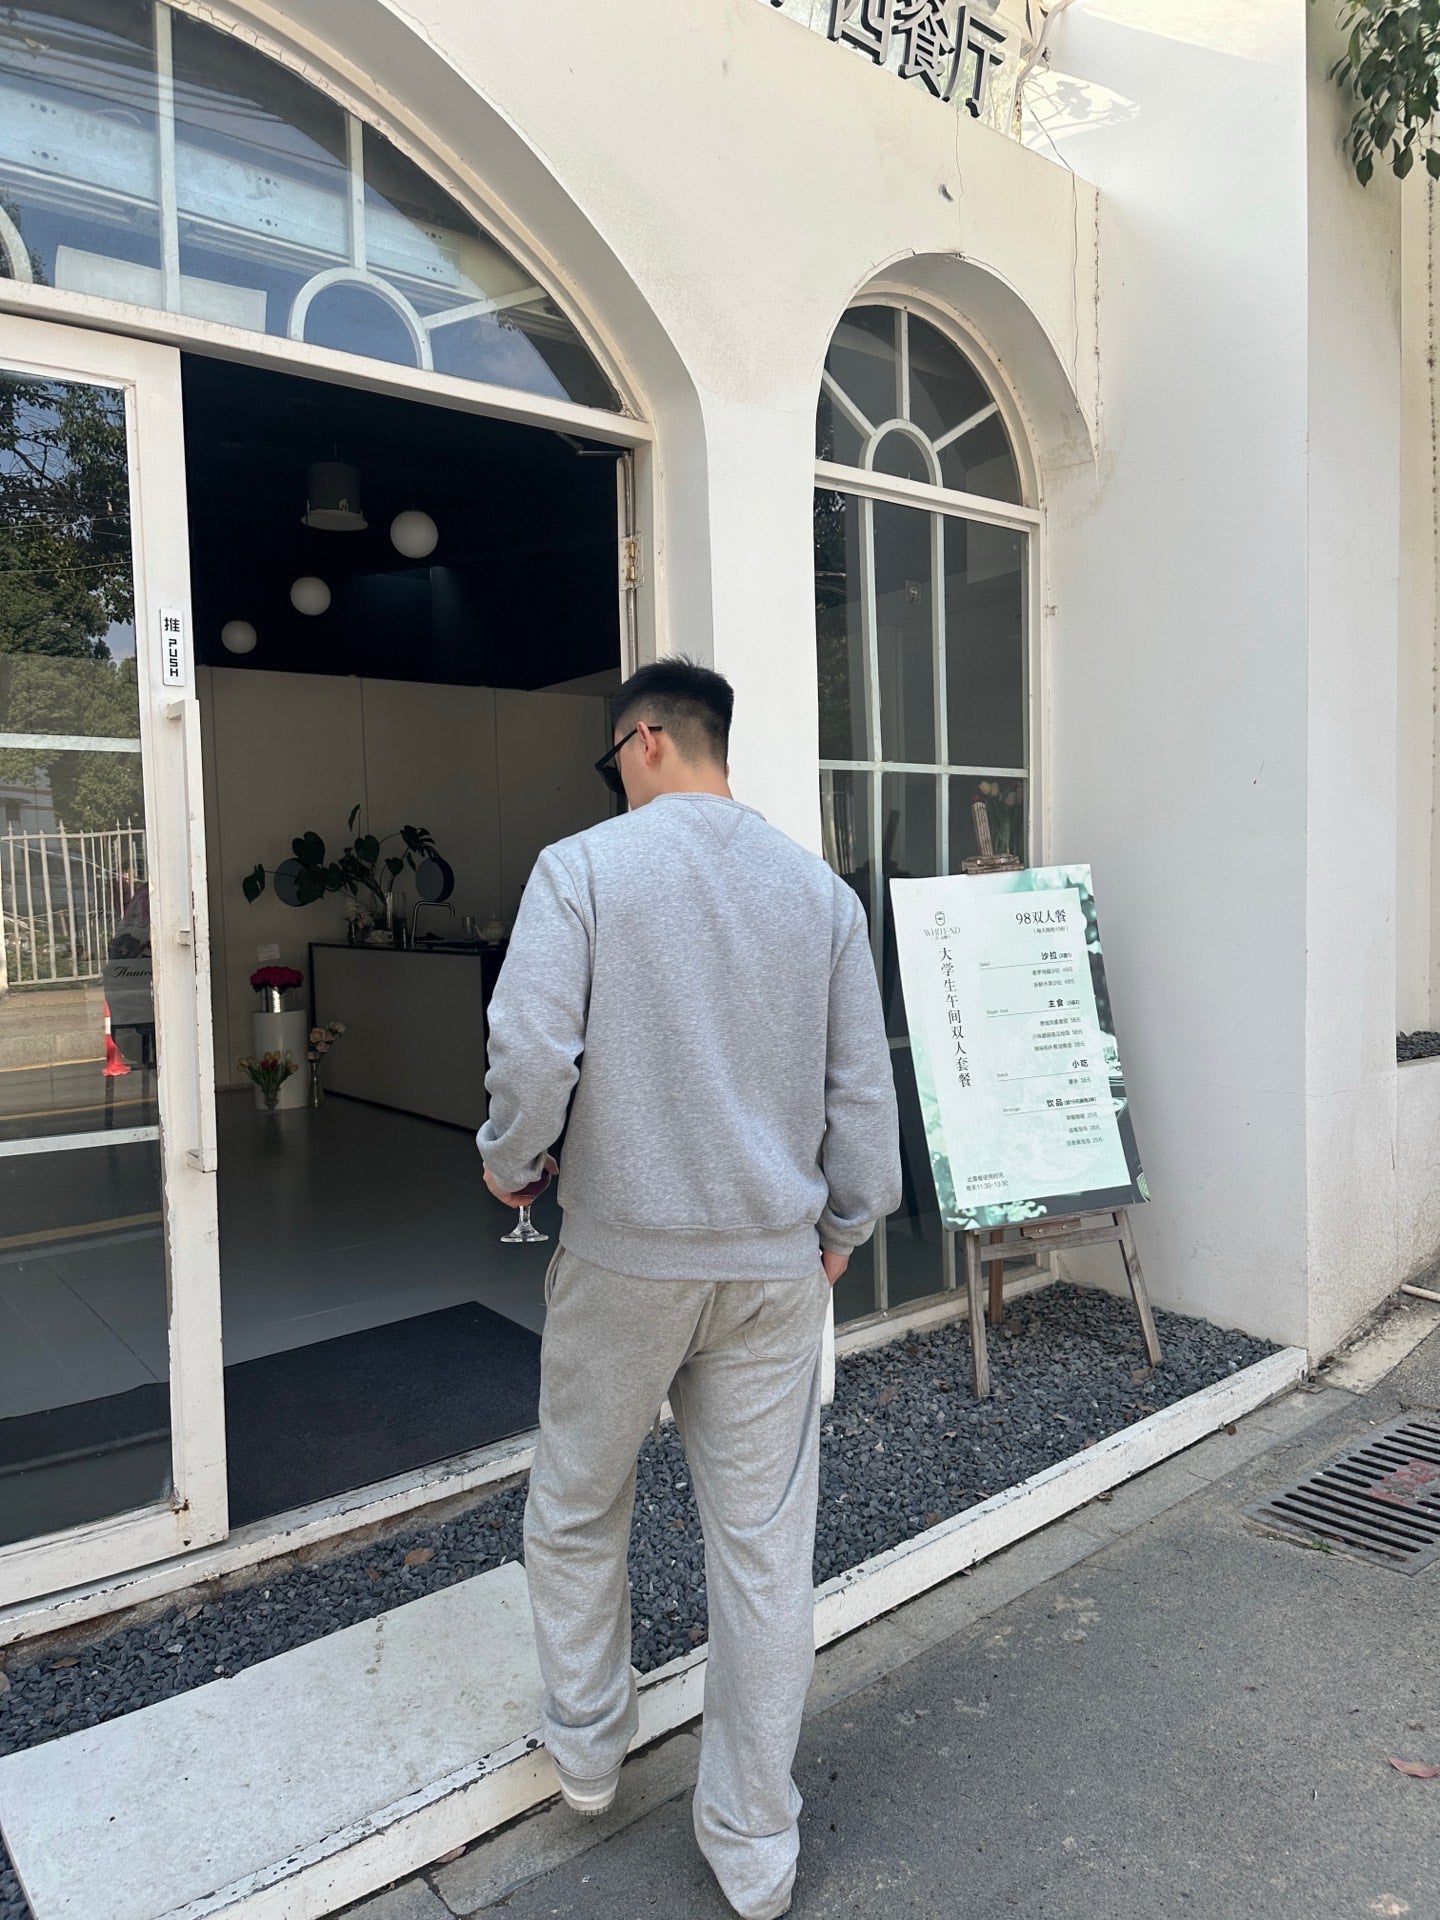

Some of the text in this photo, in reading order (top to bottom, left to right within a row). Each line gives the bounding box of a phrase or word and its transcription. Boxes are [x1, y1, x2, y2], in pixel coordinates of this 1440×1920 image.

[770, 0, 1008, 118] 西餐厅
[164, 617, 180, 632] 推
[168, 638, 179, 677] PUSH
[1015, 909, 1067, 925] 98双人餐
[1041, 952, 1057, 960] 沙拉
[1048, 999, 1063, 1008] 主食
[940, 947, 971, 1087] 大学生午间双人套餐
[1072, 1059, 1088, 1068] 小吃
[1046, 1098, 1063, 1107] 饮品
